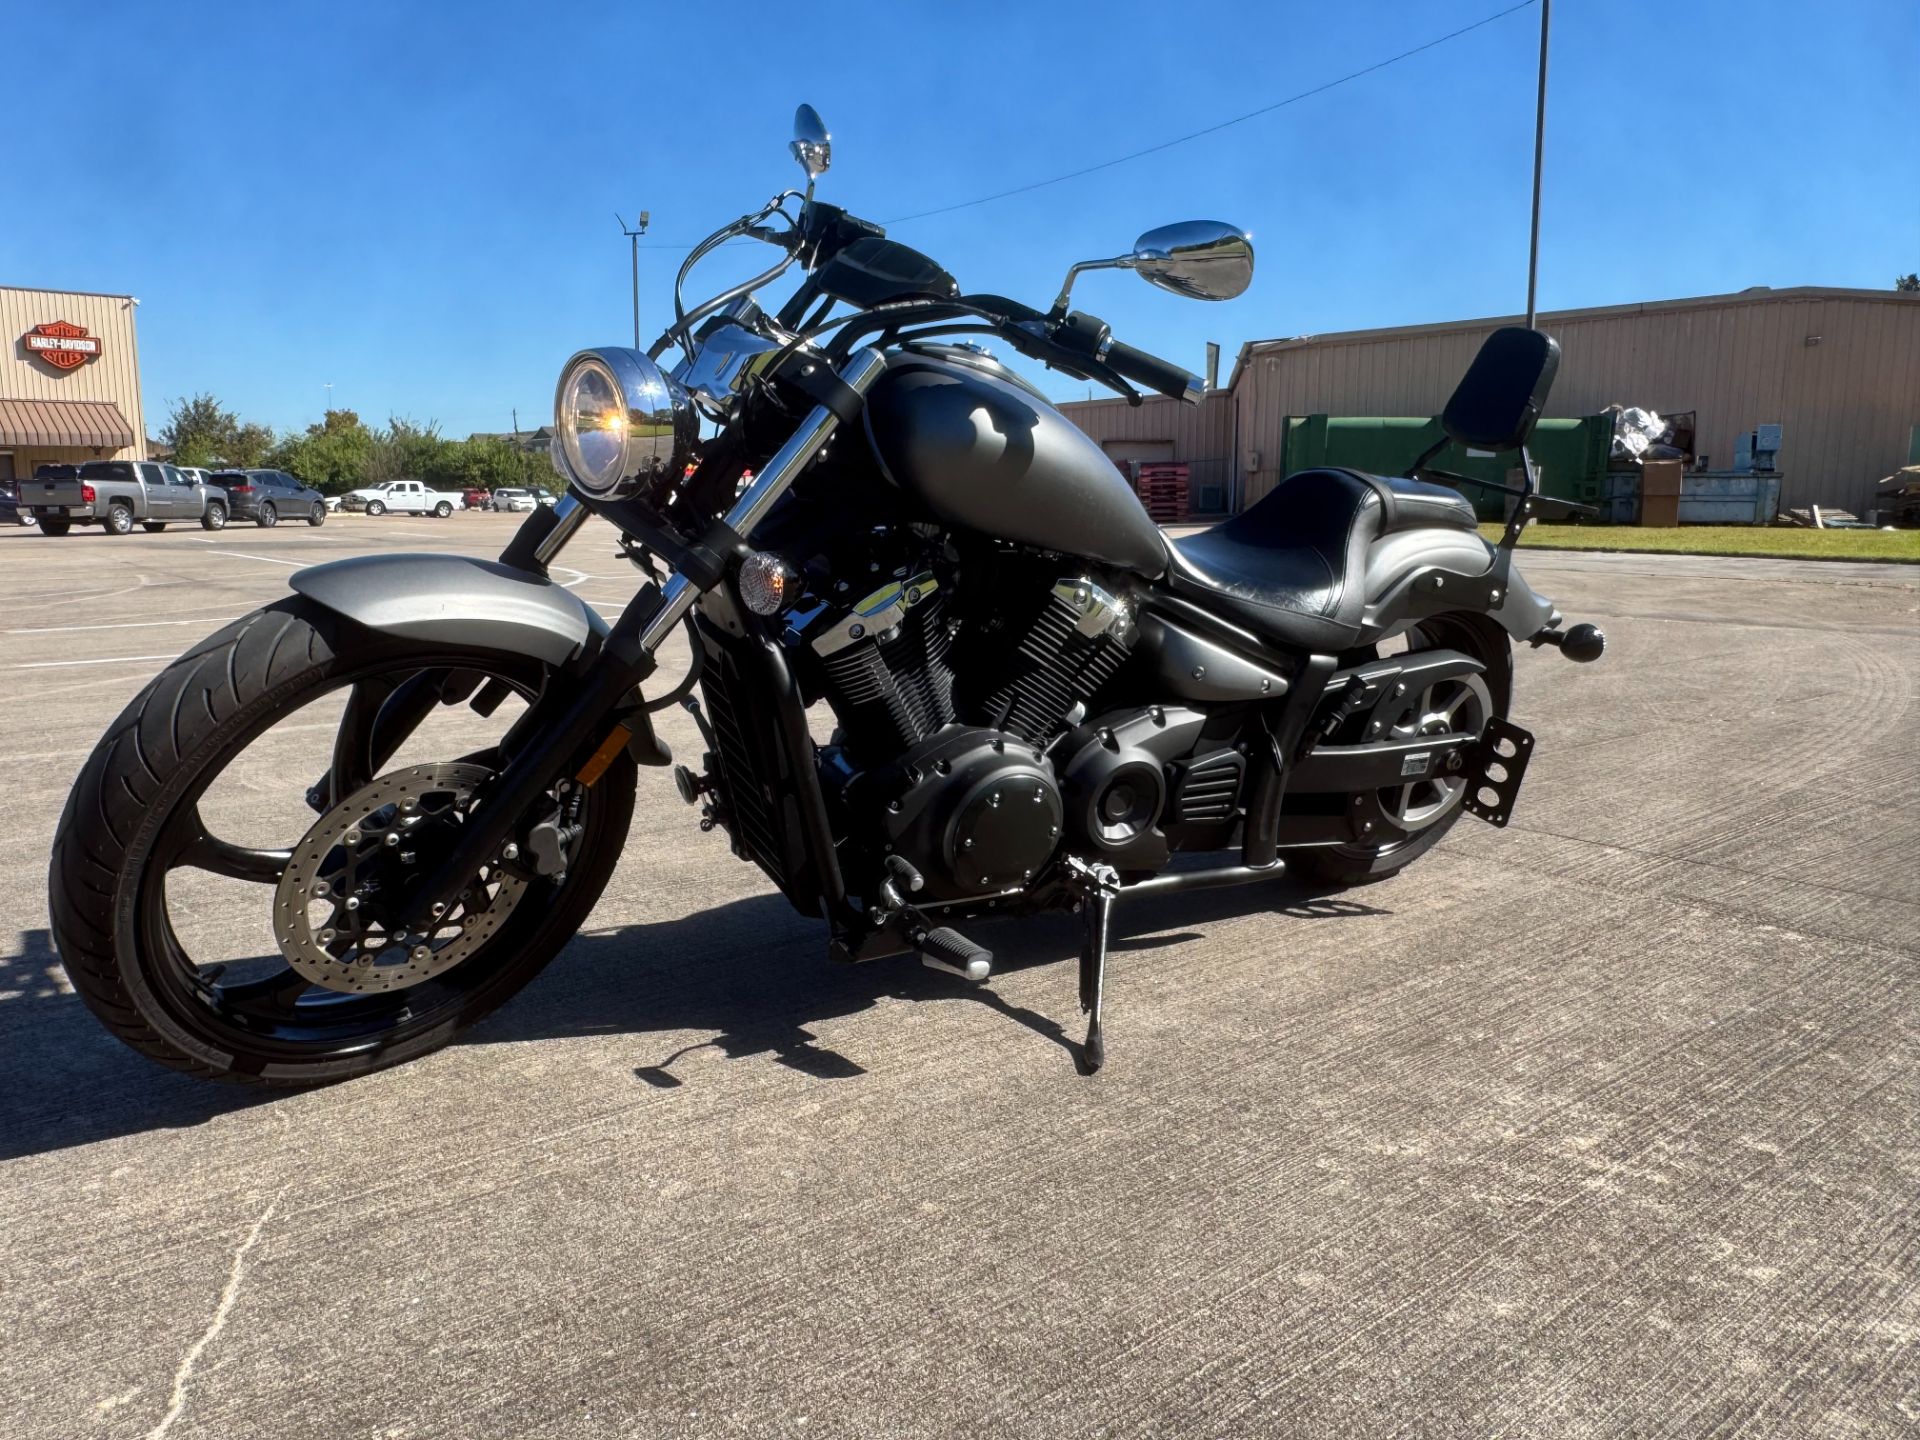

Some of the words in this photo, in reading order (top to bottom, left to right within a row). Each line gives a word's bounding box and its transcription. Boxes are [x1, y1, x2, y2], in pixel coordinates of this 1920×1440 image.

[45, 326, 80, 337] MOTOR
[30, 336, 96, 351] HARLEY-DAVIDSON
[46, 351, 82, 365] CYCLES
